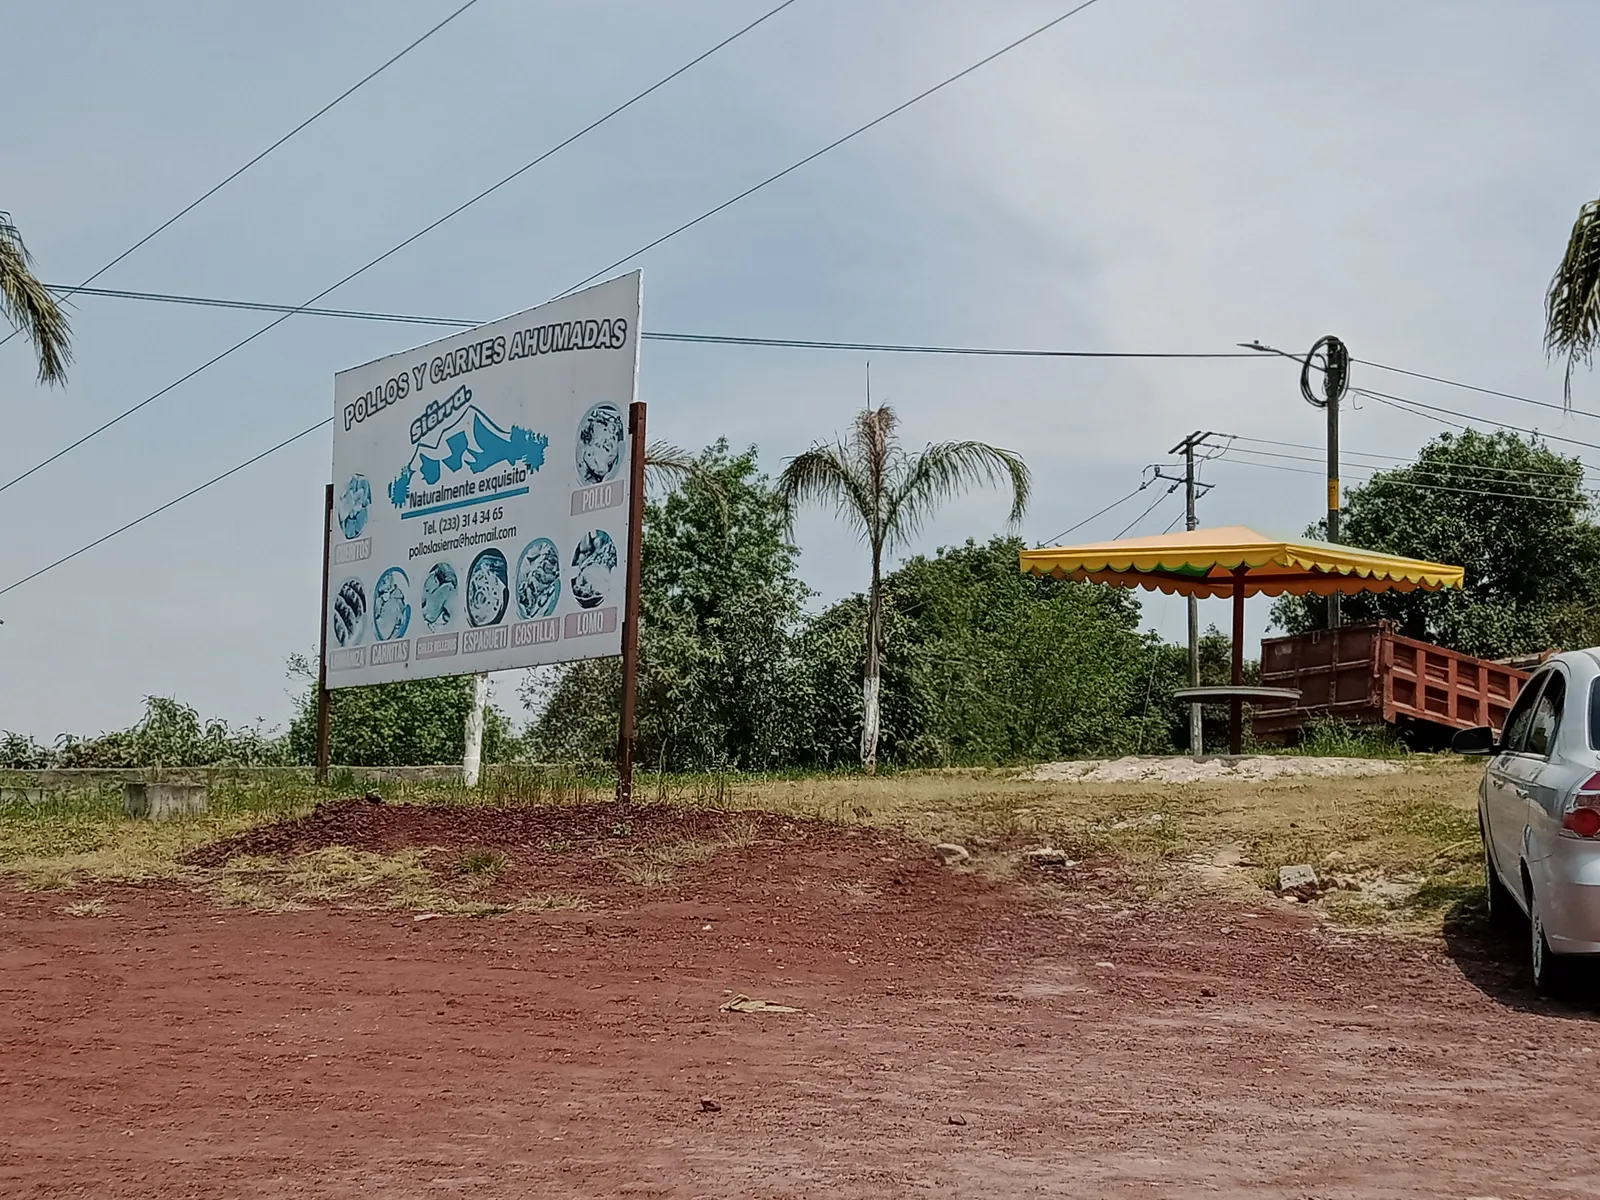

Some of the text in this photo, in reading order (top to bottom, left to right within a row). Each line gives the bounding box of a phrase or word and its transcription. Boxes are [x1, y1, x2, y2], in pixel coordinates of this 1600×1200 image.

[343, 318, 628, 431] POLLOS Y CARNES AHUMADAS
[582, 485, 612, 512] POLLO
[422, 521, 437, 536] Tel.
[438, 514, 460, 535] (233)
[479, 509, 491, 524] 34
[492, 506, 504, 520] 65
[408, 525, 517, 561] polloslasierra@hotmail.com
[515, 620, 556, 646] COSTILLA
[576, 611, 604, 635] LOMO
[372, 641, 408, 664] CARNITAS
[463, 626, 507, 653] ESPAGUETI
